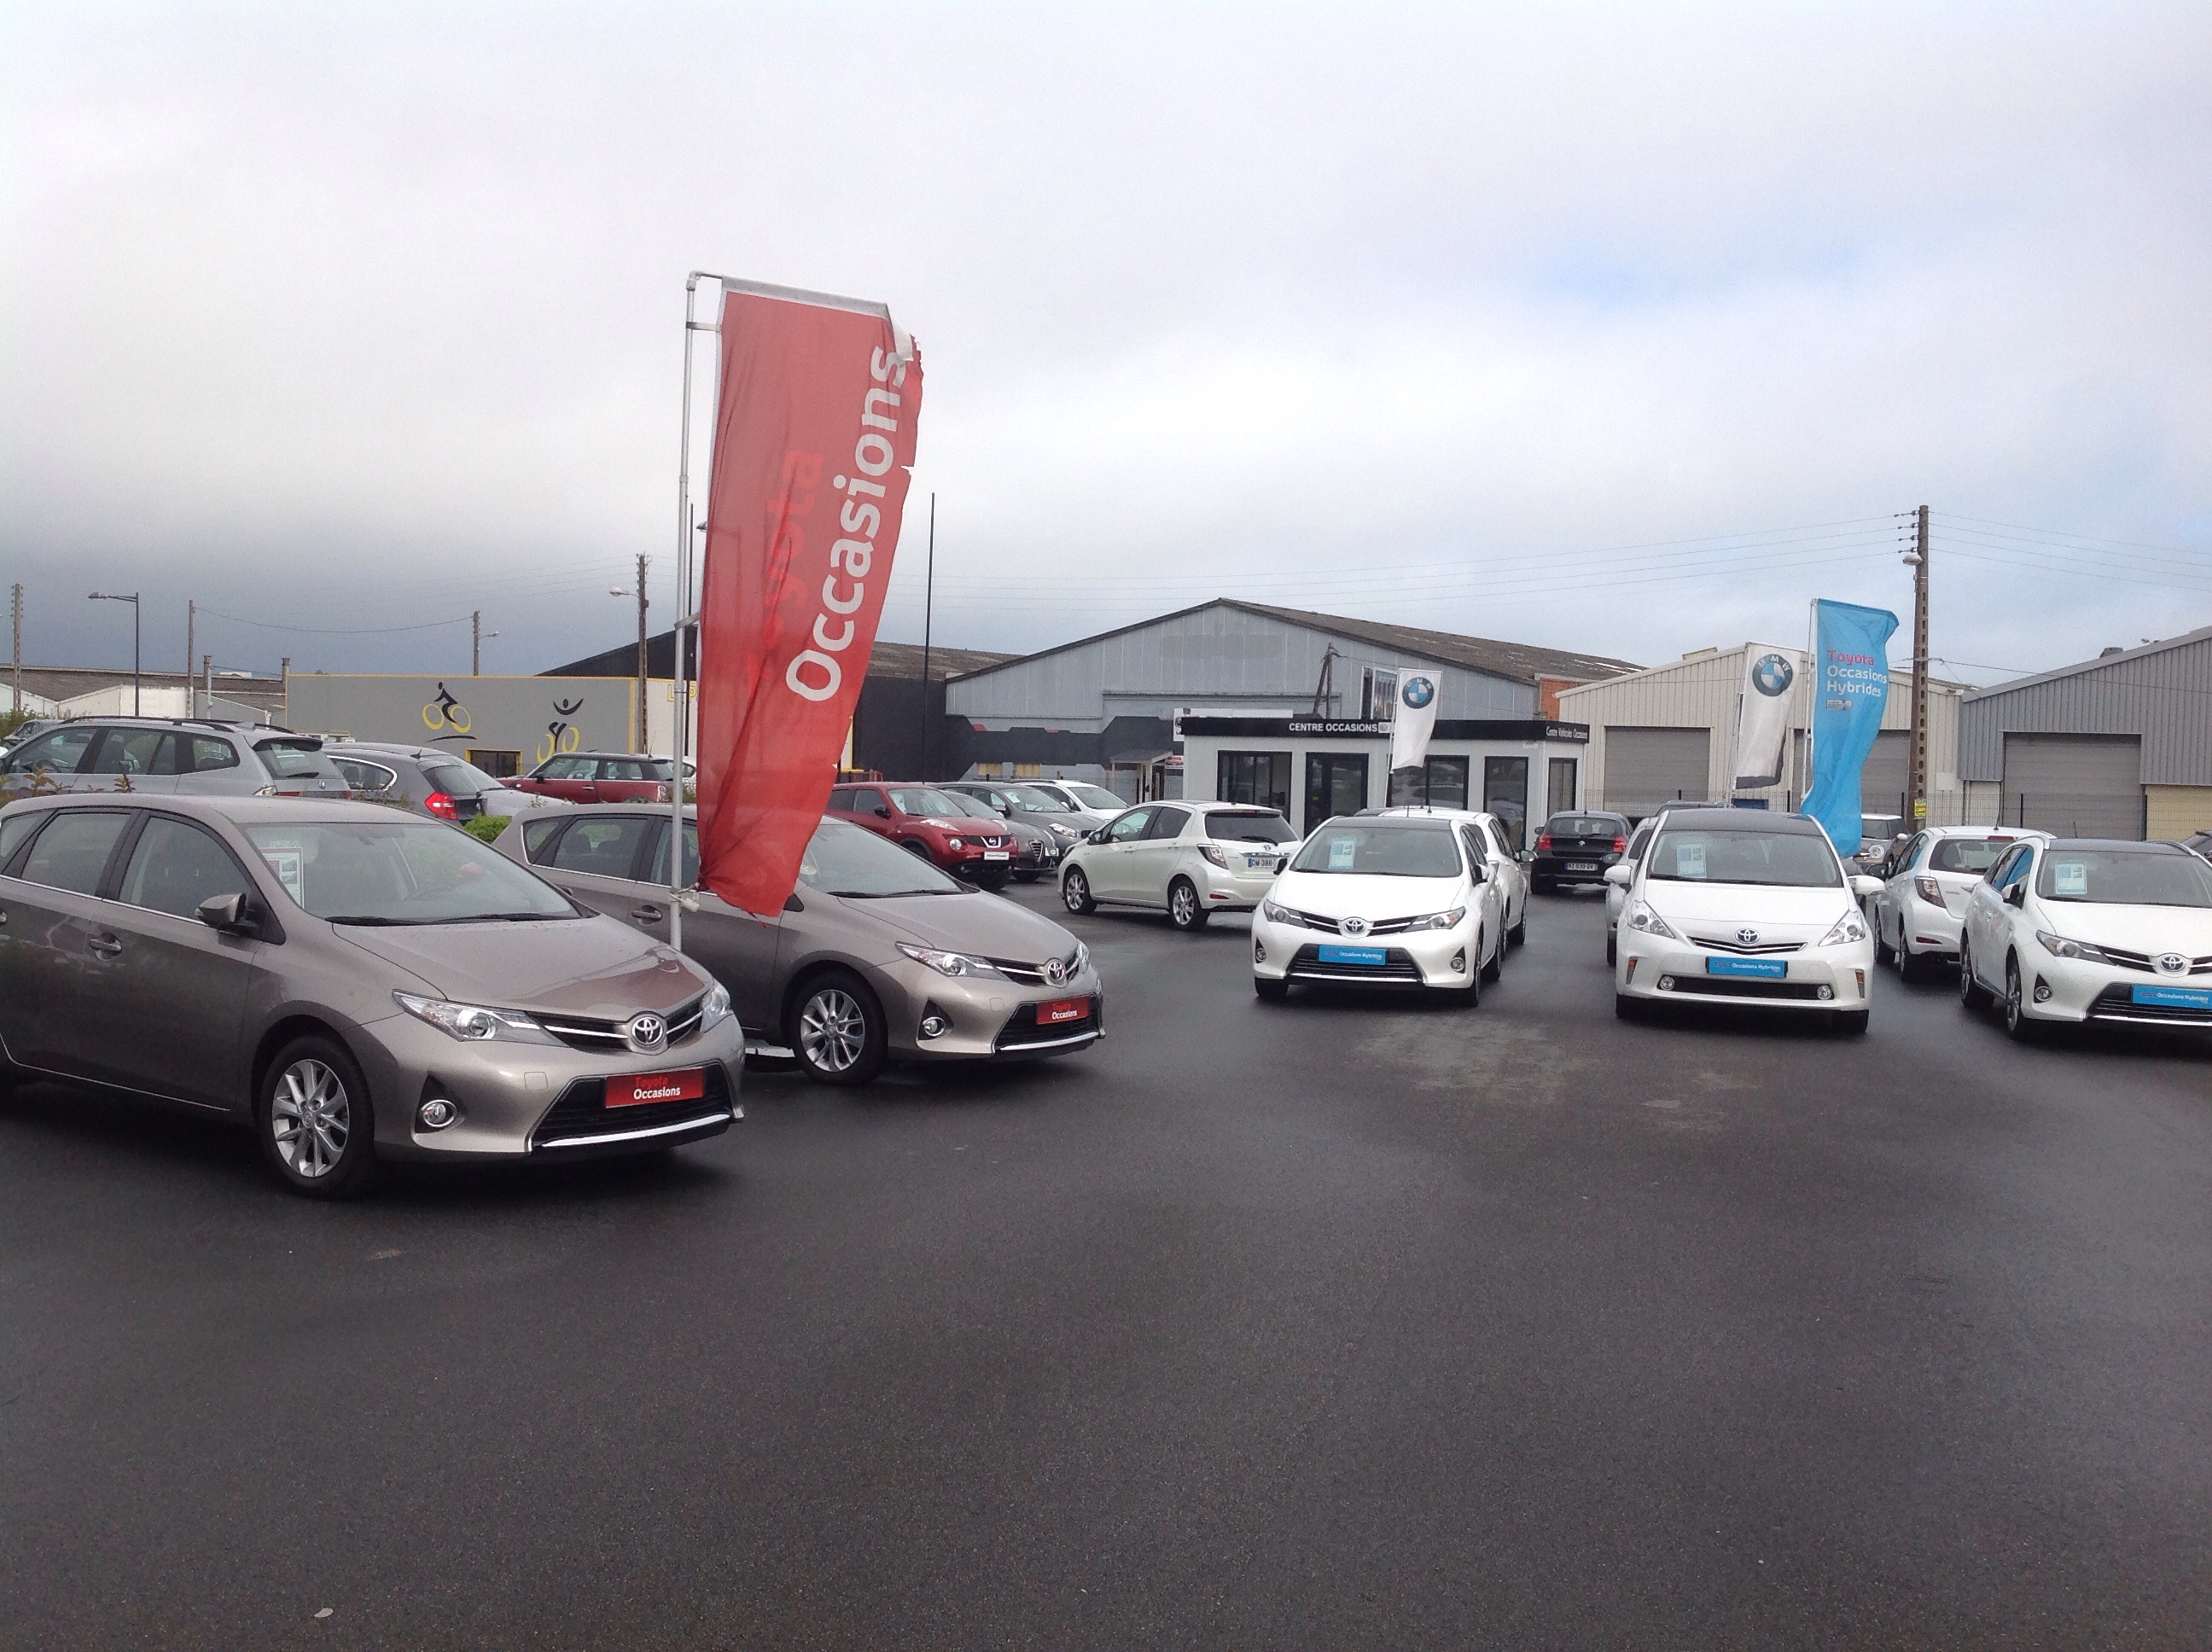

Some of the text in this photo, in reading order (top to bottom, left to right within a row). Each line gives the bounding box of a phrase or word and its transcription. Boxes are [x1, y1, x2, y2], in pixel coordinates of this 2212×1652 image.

[786, 345, 907, 701] Occasions
[1827, 649, 1874, 666] Toyota
[1827, 665, 1888, 683] Occasions
[1826, 680, 1882, 697] Hybrides
[1289, 723, 1377, 732] CENTRE OCCASIONS
[1051, 1009, 1078, 1020] Occasions
[635, 1076, 668, 1089] Toyota
[633, 1086, 681, 1100] Occasions
